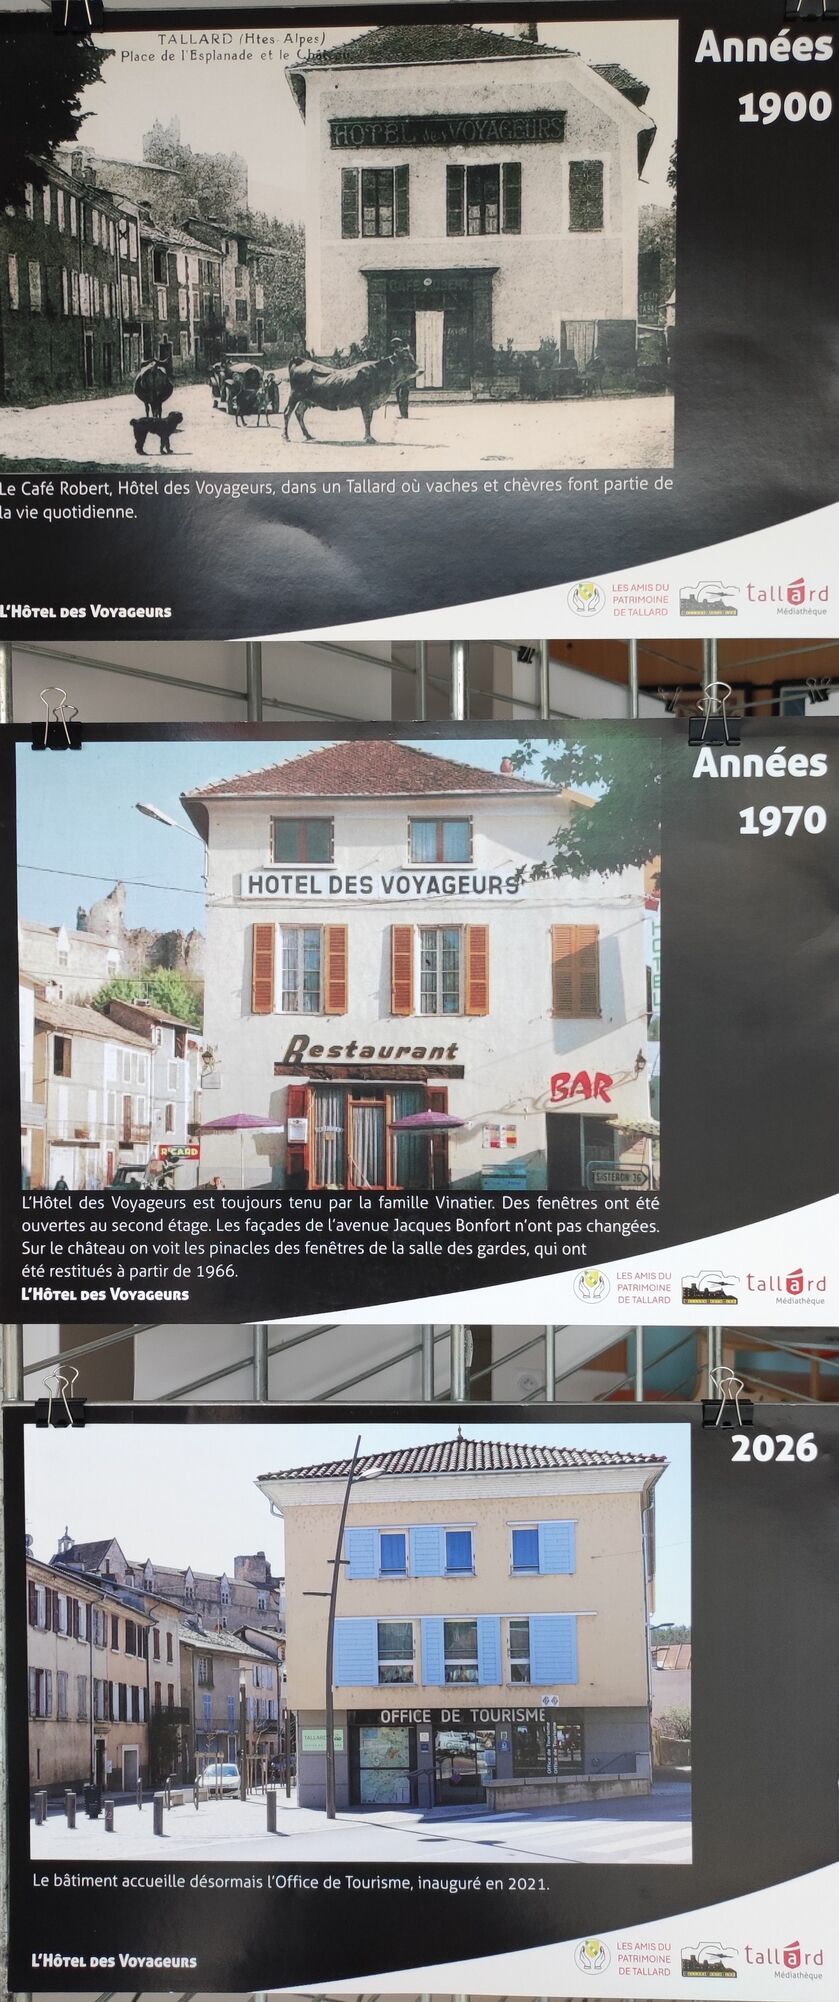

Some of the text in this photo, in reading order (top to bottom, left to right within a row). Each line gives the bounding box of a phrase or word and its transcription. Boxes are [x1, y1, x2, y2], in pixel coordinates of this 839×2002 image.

[157, 32, 233, 46] TALLARD
[694, 28, 834, 63] Années
[121, 50, 156, 63] Place
[160, 49, 175, 62] de
[260, 49, 273, 61] et
[279, 49, 290, 61] le
[738, 91, 833, 125] 1900
[335, 120, 416, 146] HOTEL
[449, 117, 564, 142] VOYAGEURS
[0, 475, 674, 498] Le Café Robert, Hôtel des Voyageurs, dans un Tallard où vaches et chèvres font partie de
[0, 504, 138, 523] la vie quotidienne.
[612, 583, 670, 592] LES AMIS DU
[612, 595, 669, 605] PATRIMOINE
[613, 607, 669, 617] DE TALLARD
[692, 746, 828, 778] Années
[739, 805, 827, 837] 1970
[248, 874, 519, 895] HOTEL DES VOYAGEURS
[283, 1034, 459, 1063] Restaurant
[550, 1069, 613, 1104] BAR
[22, 1195, 660, 1213] L'Hôtel des Voyageurs est toujours tenu par la famille Vinatier. Des fenêtres ont été
[21, 1217, 660, 1237] ouvertes au second étage. Les façades de l'avenue Jacques Bonfort n'ont pas changées.
[21, 1240, 587, 1259] Sur le château on voit les pinacles des fenêtres de la salle des gardes, qui ont
[21, 1263, 238, 1281] été restitués à partir de 1966.
[616, 1271, 672, 1280] LES AMIS DU
[617, 1283, 672, 1292] PATRIMOINE
[617, 1295, 671, 1304] DE TALLARD
[775, 1297, 825, 1306] Médiathèque
[731, 1432, 818, 1462] 2026
[380, 1707, 546, 1724] OFFICE DE TOURISME
[33, 1872, 550, 1894] Le bâtiment accueille désormais l'Office de Tourisme, inauguré en 2021.
[616, 1942, 672, 1952] LES AMIS DU
[617, 1954, 671, 1964] PATRIMOINE
[618, 1966, 671, 1977] DE TALLARD
[774, 1970, 823, 1981] Médiathèque
